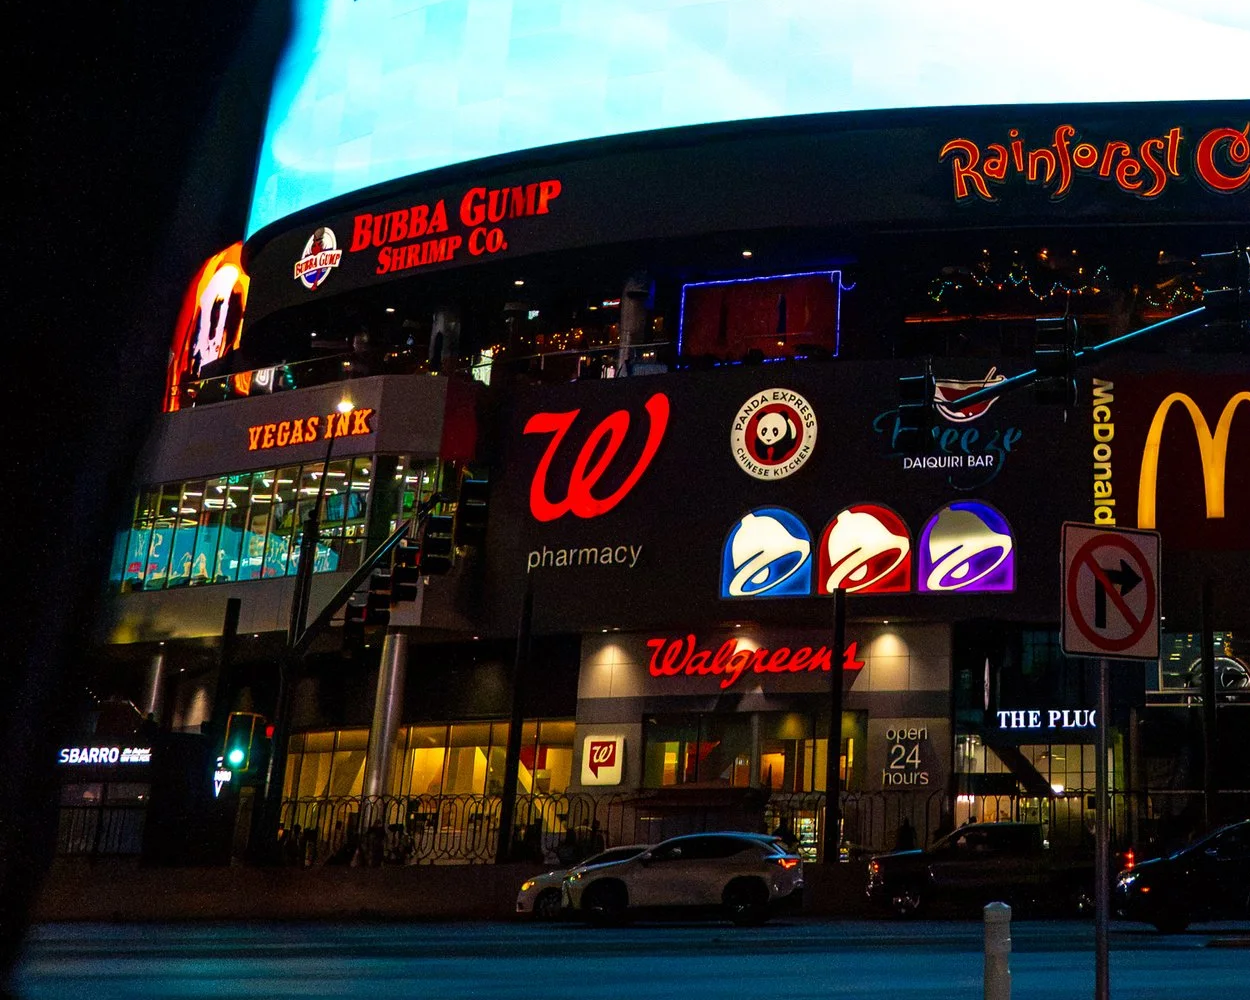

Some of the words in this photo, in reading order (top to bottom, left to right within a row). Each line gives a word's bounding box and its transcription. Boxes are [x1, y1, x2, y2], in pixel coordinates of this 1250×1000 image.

[939, 124, 1184, 200] Rainforest
[350, 199, 449, 252] BUBBA
[459, 179, 562, 227] GUMP
[295, 257, 318, 277] BUBBA
[319, 253, 341, 266] GUMP
[376, 235, 462, 275] SHRIMP
[468, 227, 508, 256] CO.
[735, 395, 768, 431] PANDA
[772, 391, 815, 428] EXPRESS
[249, 416, 319, 450] VEGAS
[324, 408, 373, 438] INK
[736, 447, 770, 477] CHINESE
[773, 445, 811, 476] KITCHEN
[903, 457, 963, 470] DAIQUIRI
[967, 455, 994, 468] BAR
[527, 544, 643, 574] pharmacy
[646, 633, 866, 689] Walgreens
[886, 727, 928, 743] open
[997, 711, 1042, 729] THE
[59, 747, 119, 763] SBARRO
[890, 745, 921, 770] 24
[881, 770, 929, 786] hours
